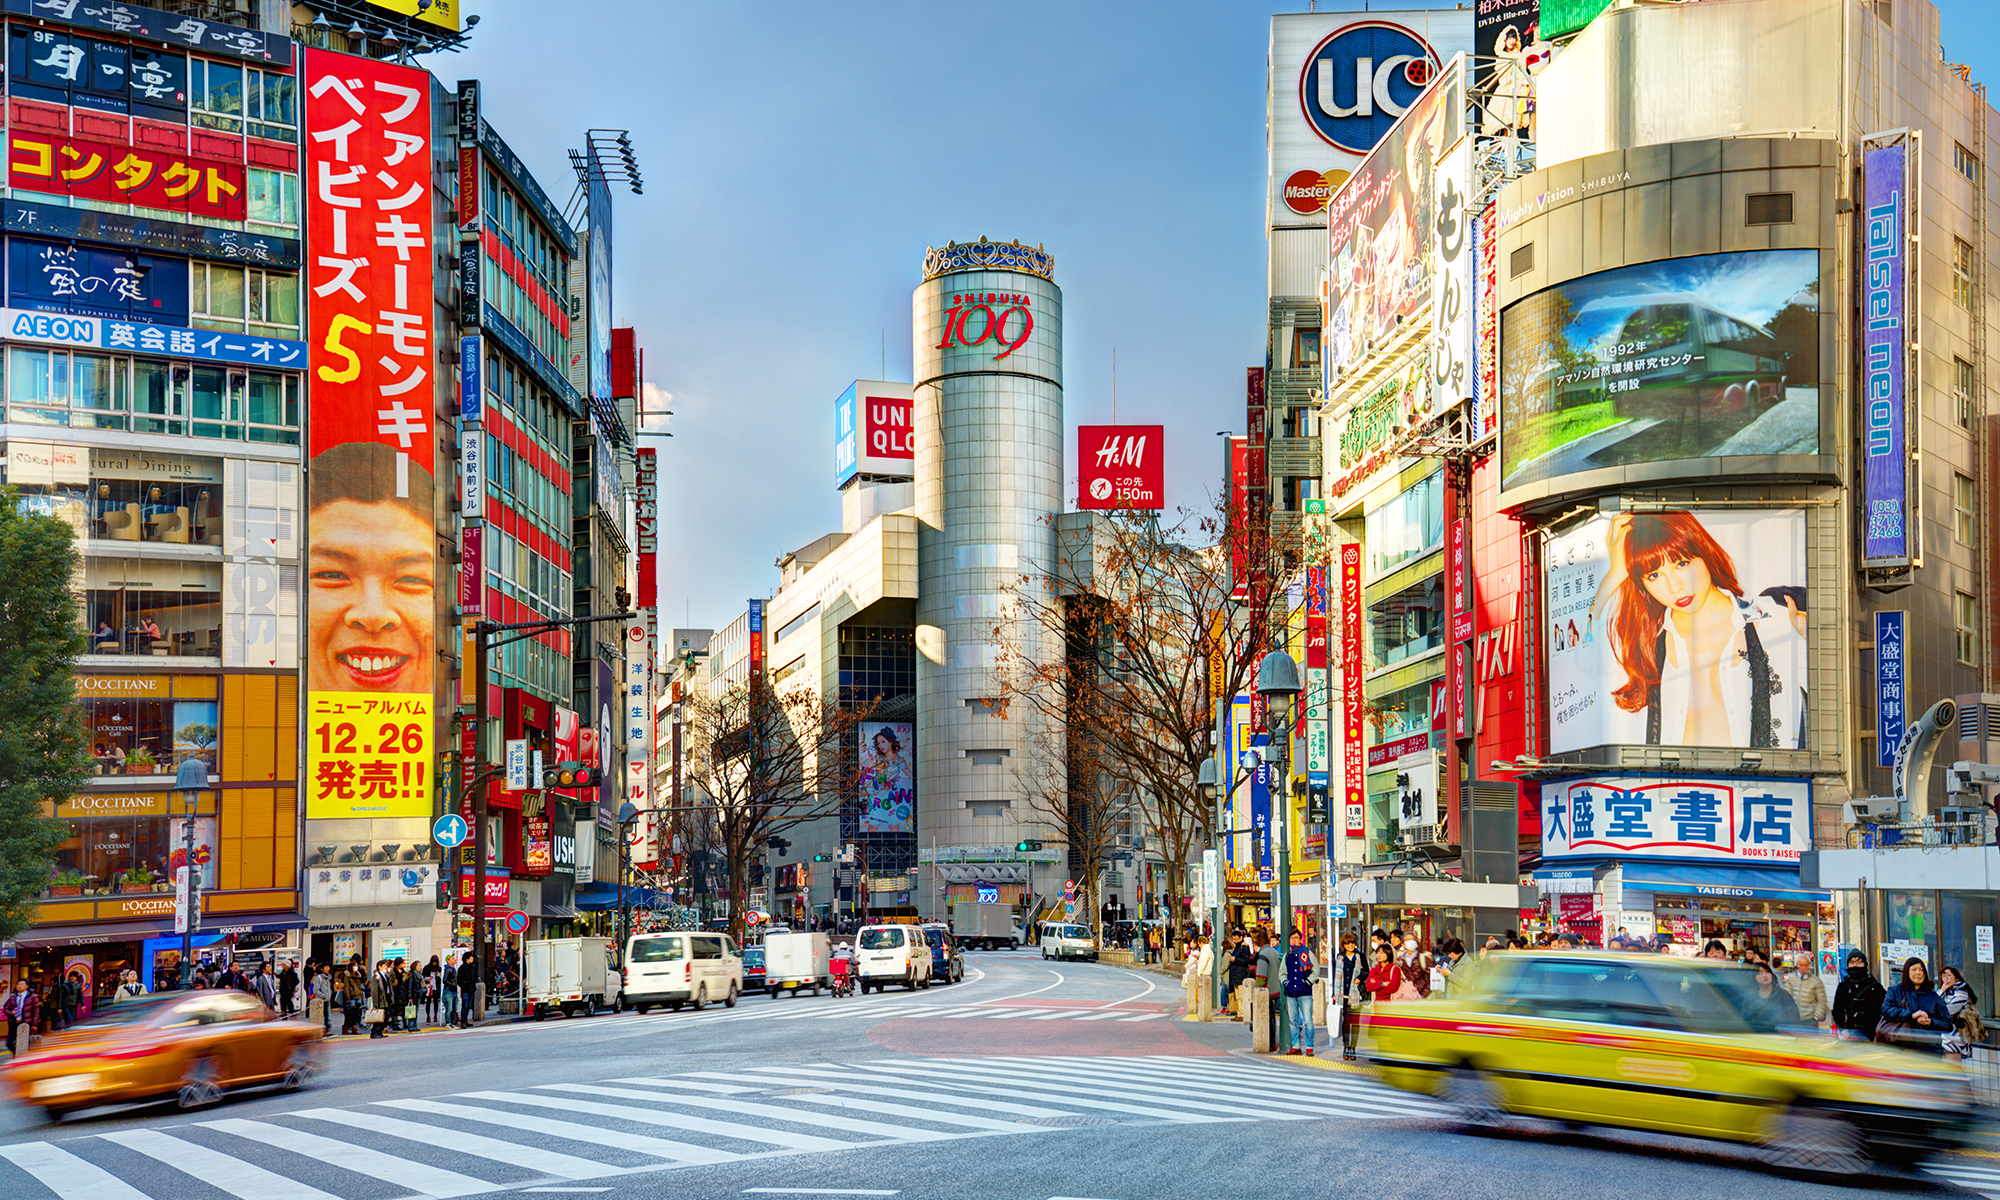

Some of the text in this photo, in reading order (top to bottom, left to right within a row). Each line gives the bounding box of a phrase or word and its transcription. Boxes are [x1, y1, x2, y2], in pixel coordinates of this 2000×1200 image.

[1478, 16, 1496, 28] DVD
[1503, 8, 1530, 20] Blu-ray
[33, 30, 54, 44] 9F
[165, 19, 265, 57] 月の宴
[33, 44, 175, 98] 月の宴
[12, 139, 238, 204] コンタクト
[309, 74, 370, 303] ベイビーズ
[463, 149, 475, 220] プライス コンタクト
[1285, 184, 1338, 199] MasterC
[1500, 171, 1631, 228] Mighty Vision SHIBUYA
[16, 209, 38, 225] 7F
[100, 224, 212, 245] MODERN JAPANESE DINING
[467, 222, 479, 231] 8F
[374, 80, 428, 498] ファンキーモンキー
[1436, 178, 1464, 396] もんじゃ
[953, 293, 1031, 306] SHIBUYA
[78, 309, 118, 319] JAPANESE
[465, 314, 476, 323] 7F
[935, 304, 1034, 361] 109
[1868, 190, 1898, 458] Taisei neon
[13, 315, 300, 363] AEON 英会話イーオン
[1601, 341, 1647, 359] 1992年
[465, 344, 478, 413] 英会話イーオン
[1556, 352, 1705, 387] アマゾン自然環境研究センター
[1608, 378, 1640, 394] を開設
[839, 397, 852, 435] THE
[1095, 435, 1147, 469] H&M
[138, 459, 192, 477] Dining
[465, 438, 478, 510] 渋谷駅前ビル
[1115, 477, 1143, 487] この先
[1115, 487, 1153, 501] 150m
[1871, 499, 1899, 515] (03)
[1870, 512, 1900, 527] 3719
[464, 528, 481, 538] 5F
[1869, 525, 1901, 540] 2468
[1308, 638, 1325, 647] JTB
[1881, 622, 1901, 757] 大盛堂商事ビル
[315, 700, 427, 716] ニューアルバム
[631, 663, 644, 739] 洋装生地
[315, 722, 424, 754] 12.26
[514, 743, 525, 786] 渋谷駅前
[315, 759, 425, 800] 発売!!
[71, 796, 155, 809] L'OCCITANE
[630, 761, 645, 847] マルン
[1547, 788, 1794, 845] 大盛堂書店
[554, 835, 575, 864] USH
[1742, 847, 1801, 858] BOOKS TAISEID
[1551, 871, 1573, 879] TAISEIDO
[977, 893, 998, 904] 109
[1696, 886, 1753, 897] TAISEIDO
[122, 900, 177, 912] L'OCCITAN
[219, 926, 253, 935] KIOSQUE
[310, 924, 345, 932] SHIBUYA
[349, 921, 381, 929] EKIMAE
[1781, 920, 1811, 928] GLITTER
[69, 936, 110, 945] L'OCCITANE
[250, 933, 280, 942] MEVIUS
